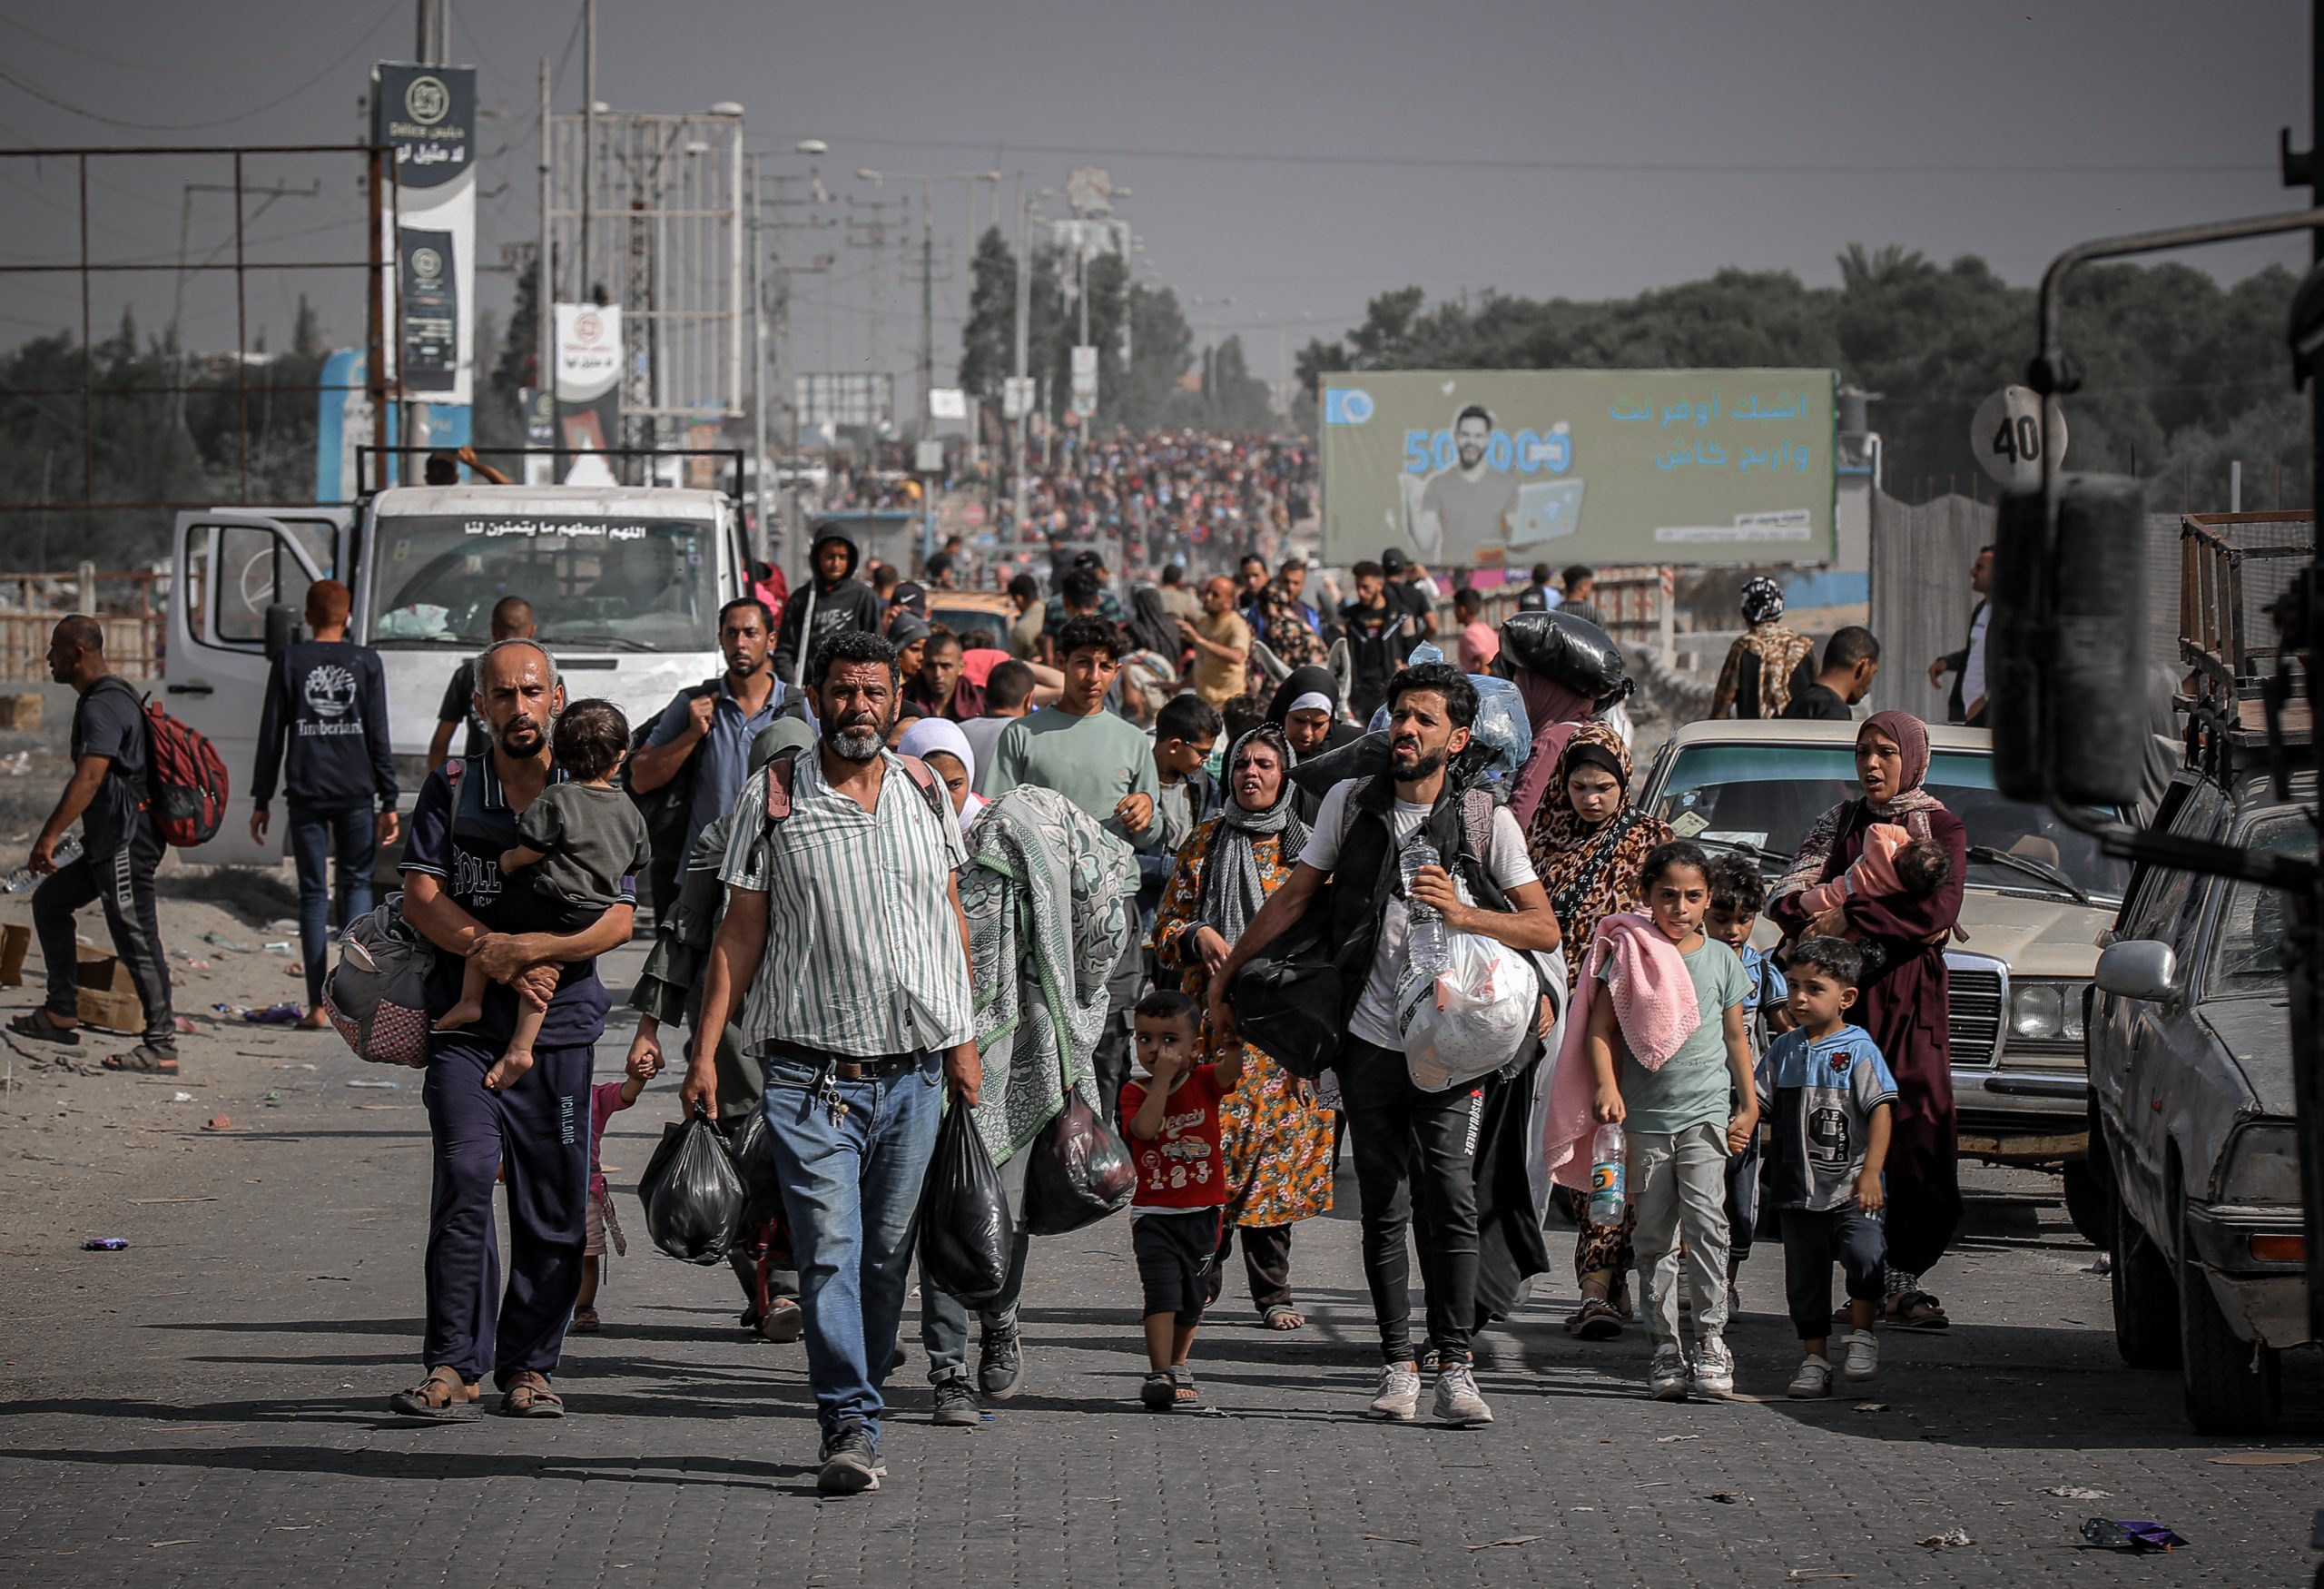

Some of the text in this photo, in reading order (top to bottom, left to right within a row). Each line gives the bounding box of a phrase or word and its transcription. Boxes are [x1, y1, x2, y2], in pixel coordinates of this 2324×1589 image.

[413, 142, 448, 165] مثيل
[1993, 415, 2040, 464] 40
[1655, 437, 1810, 473] واربح كاش
[464, 521, 485, 535] لنا
[486, 520, 537, 537] يتمنون
[539, 521, 555, 534] ما
[608, 526, 646, 540] اللهم
[1820, 1110, 1840, 1120] AE
[1150, 1160, 1209, 1189] 1 2 3
